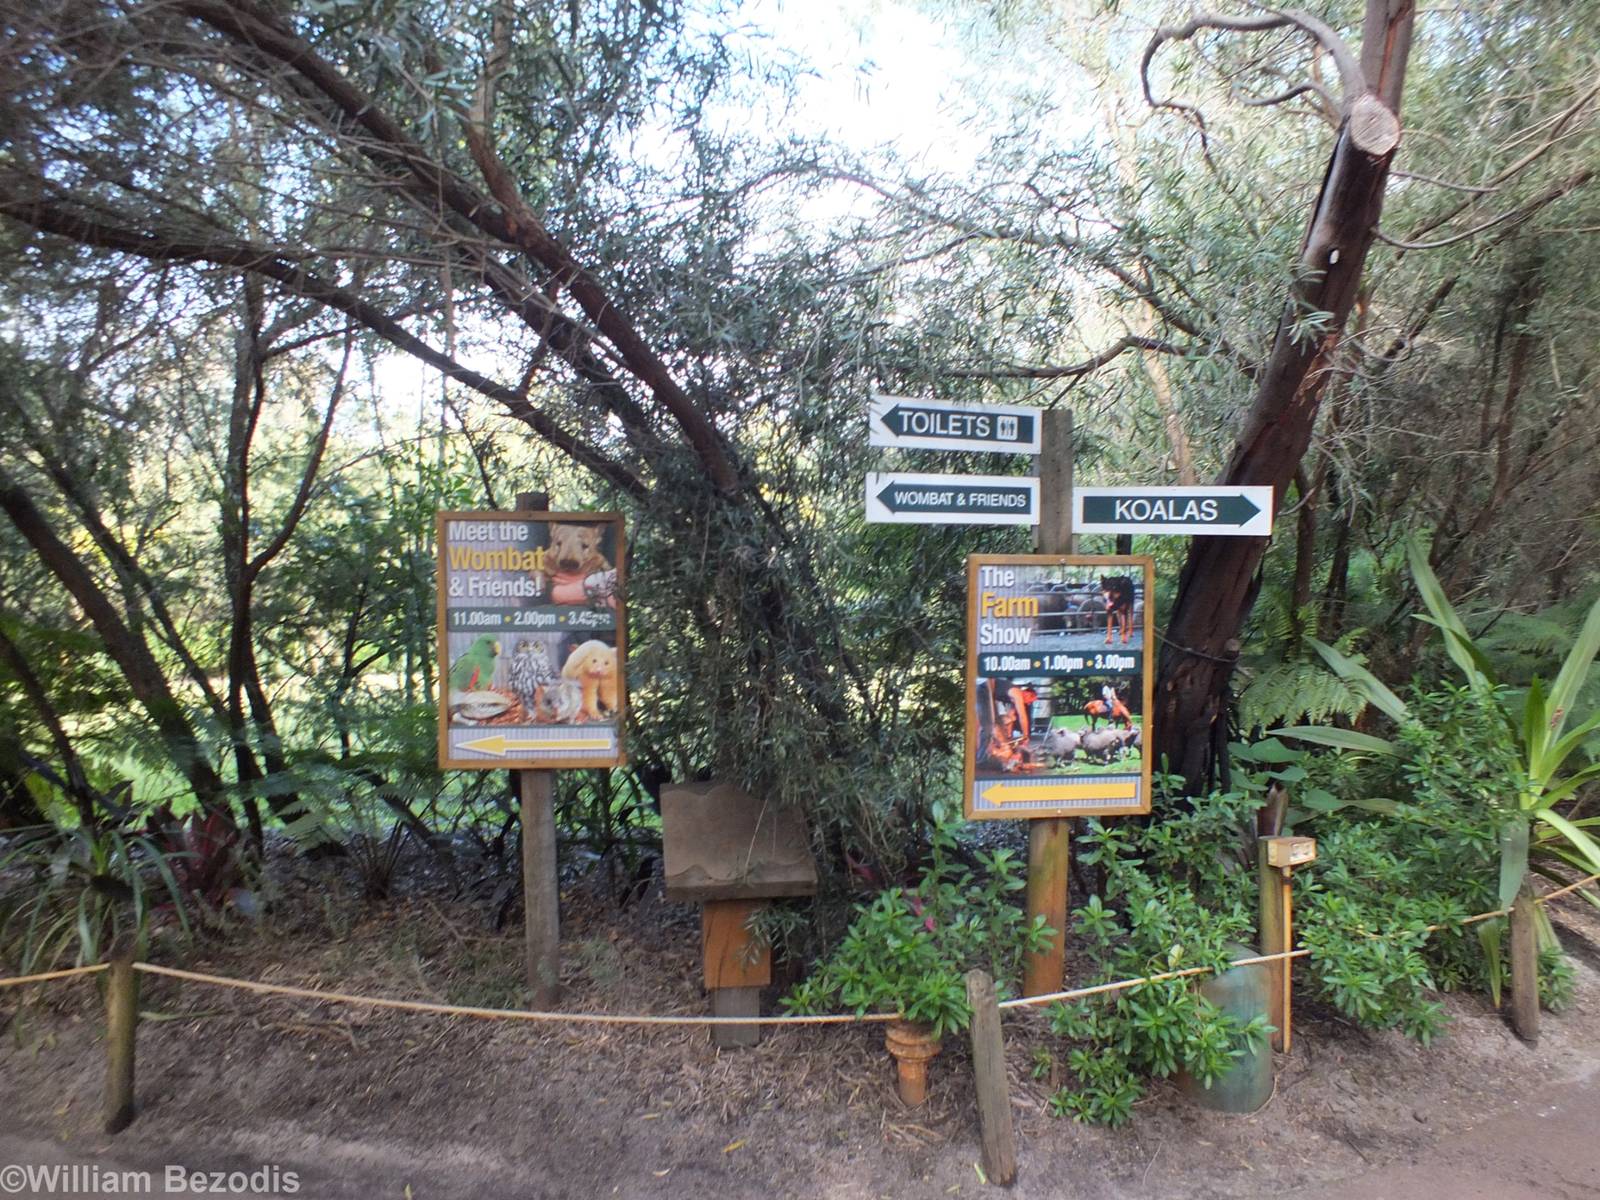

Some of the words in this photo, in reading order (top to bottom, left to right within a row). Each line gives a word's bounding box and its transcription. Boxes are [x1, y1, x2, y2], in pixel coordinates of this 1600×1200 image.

[898, 411, 990, 437] TOILETS
[894, 491, 953, 506] WOMBAT
[956, 494, 966, 506] &
[969, 493, 1026, 507] FRIENDS
[1115, 499, 1218, 521] KOALAS
[449, 521, 497, 541] Meet
[500, 521, 528, 541] the
[449, 546, 545, 571] Wombat
[449, 576, 464, 597] &
[468, 575, 541, 597] Friends!
[982, 567, 1014, 587] The
[981, 592, 1039, 618] Farm
[453, 612, 501, 625] 11.00am
[513, 611, 555, 628] 2.00pm
[980, 624, 1031, 645] Show
[984, 656, 1031, 671] 10.00am
[1043, 656, 1083, 673] 1.00pm
[1095, 654, 1135, 671] 3.00pm
